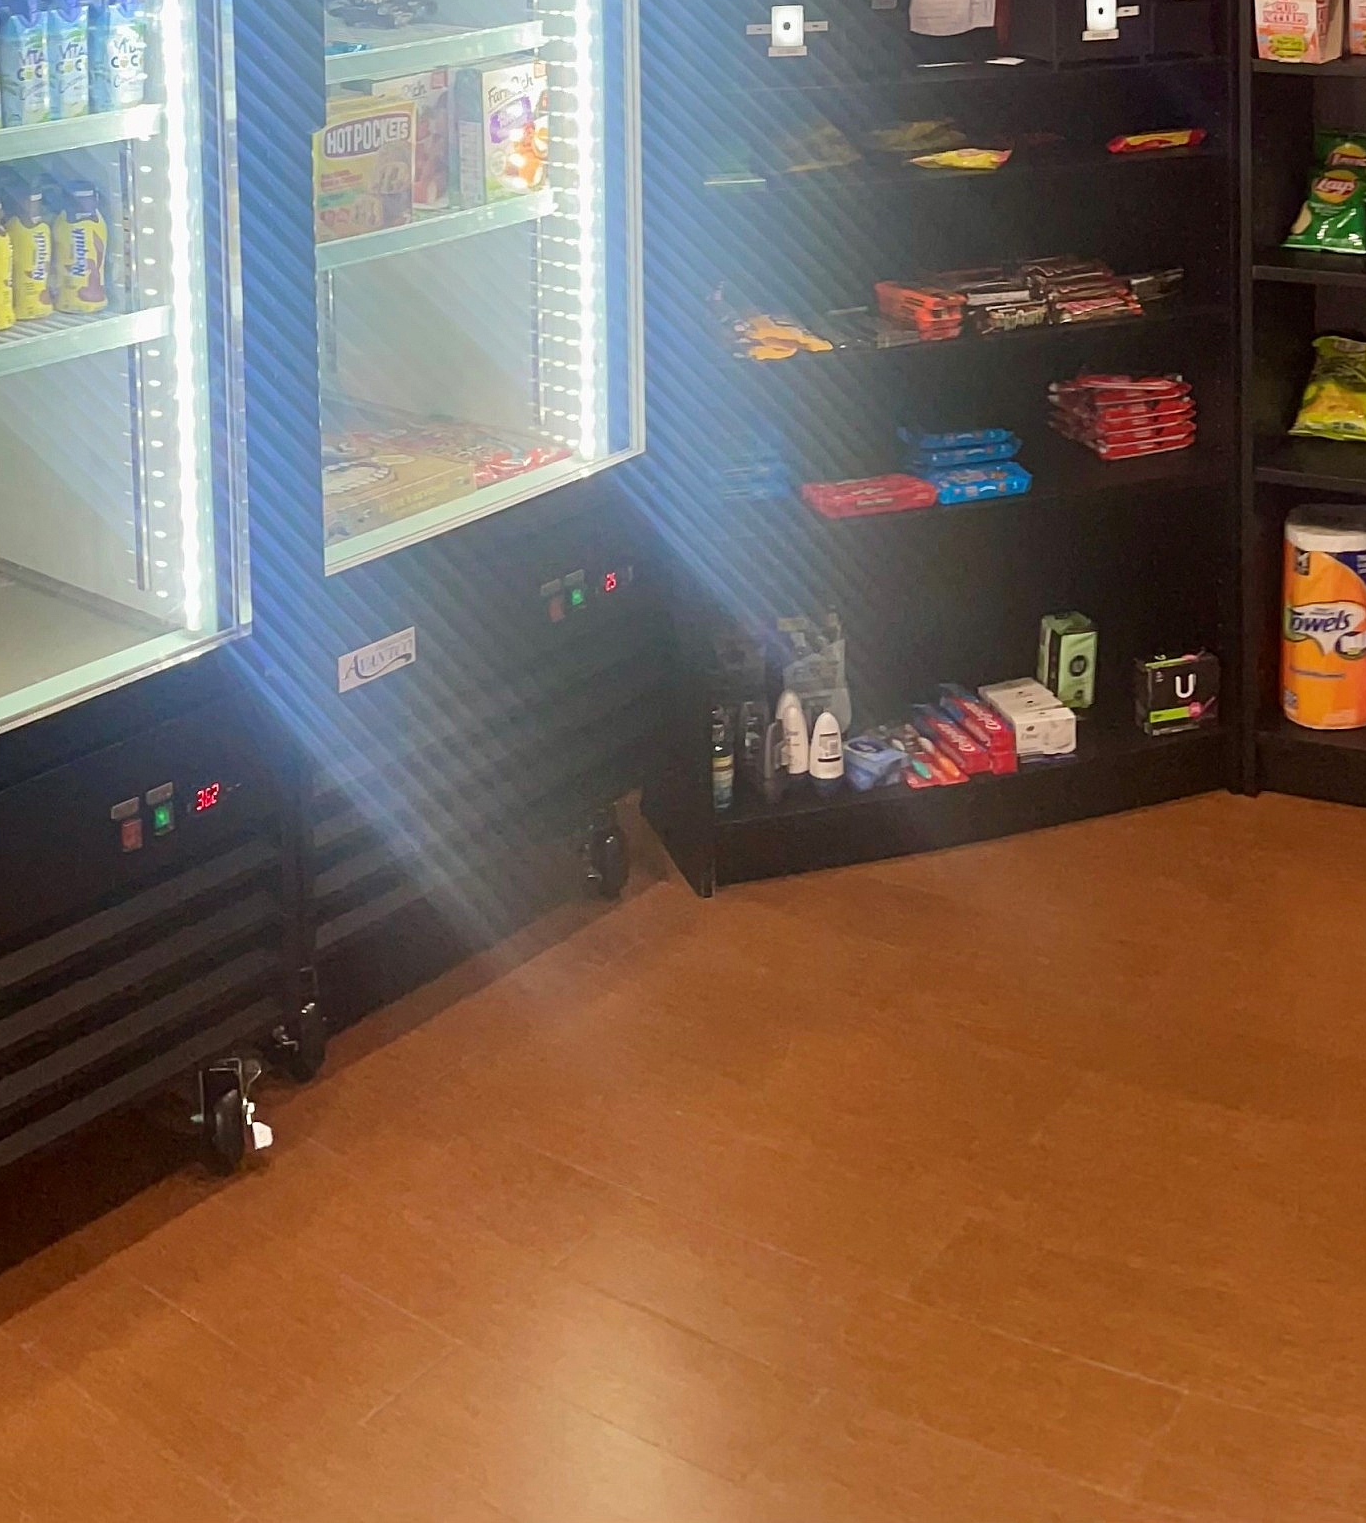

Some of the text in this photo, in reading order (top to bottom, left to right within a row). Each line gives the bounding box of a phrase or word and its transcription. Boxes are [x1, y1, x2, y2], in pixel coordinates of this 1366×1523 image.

[326, 115, 410, 155] HOT POCKETS
[71, 228, 88, 277] Nesquik
